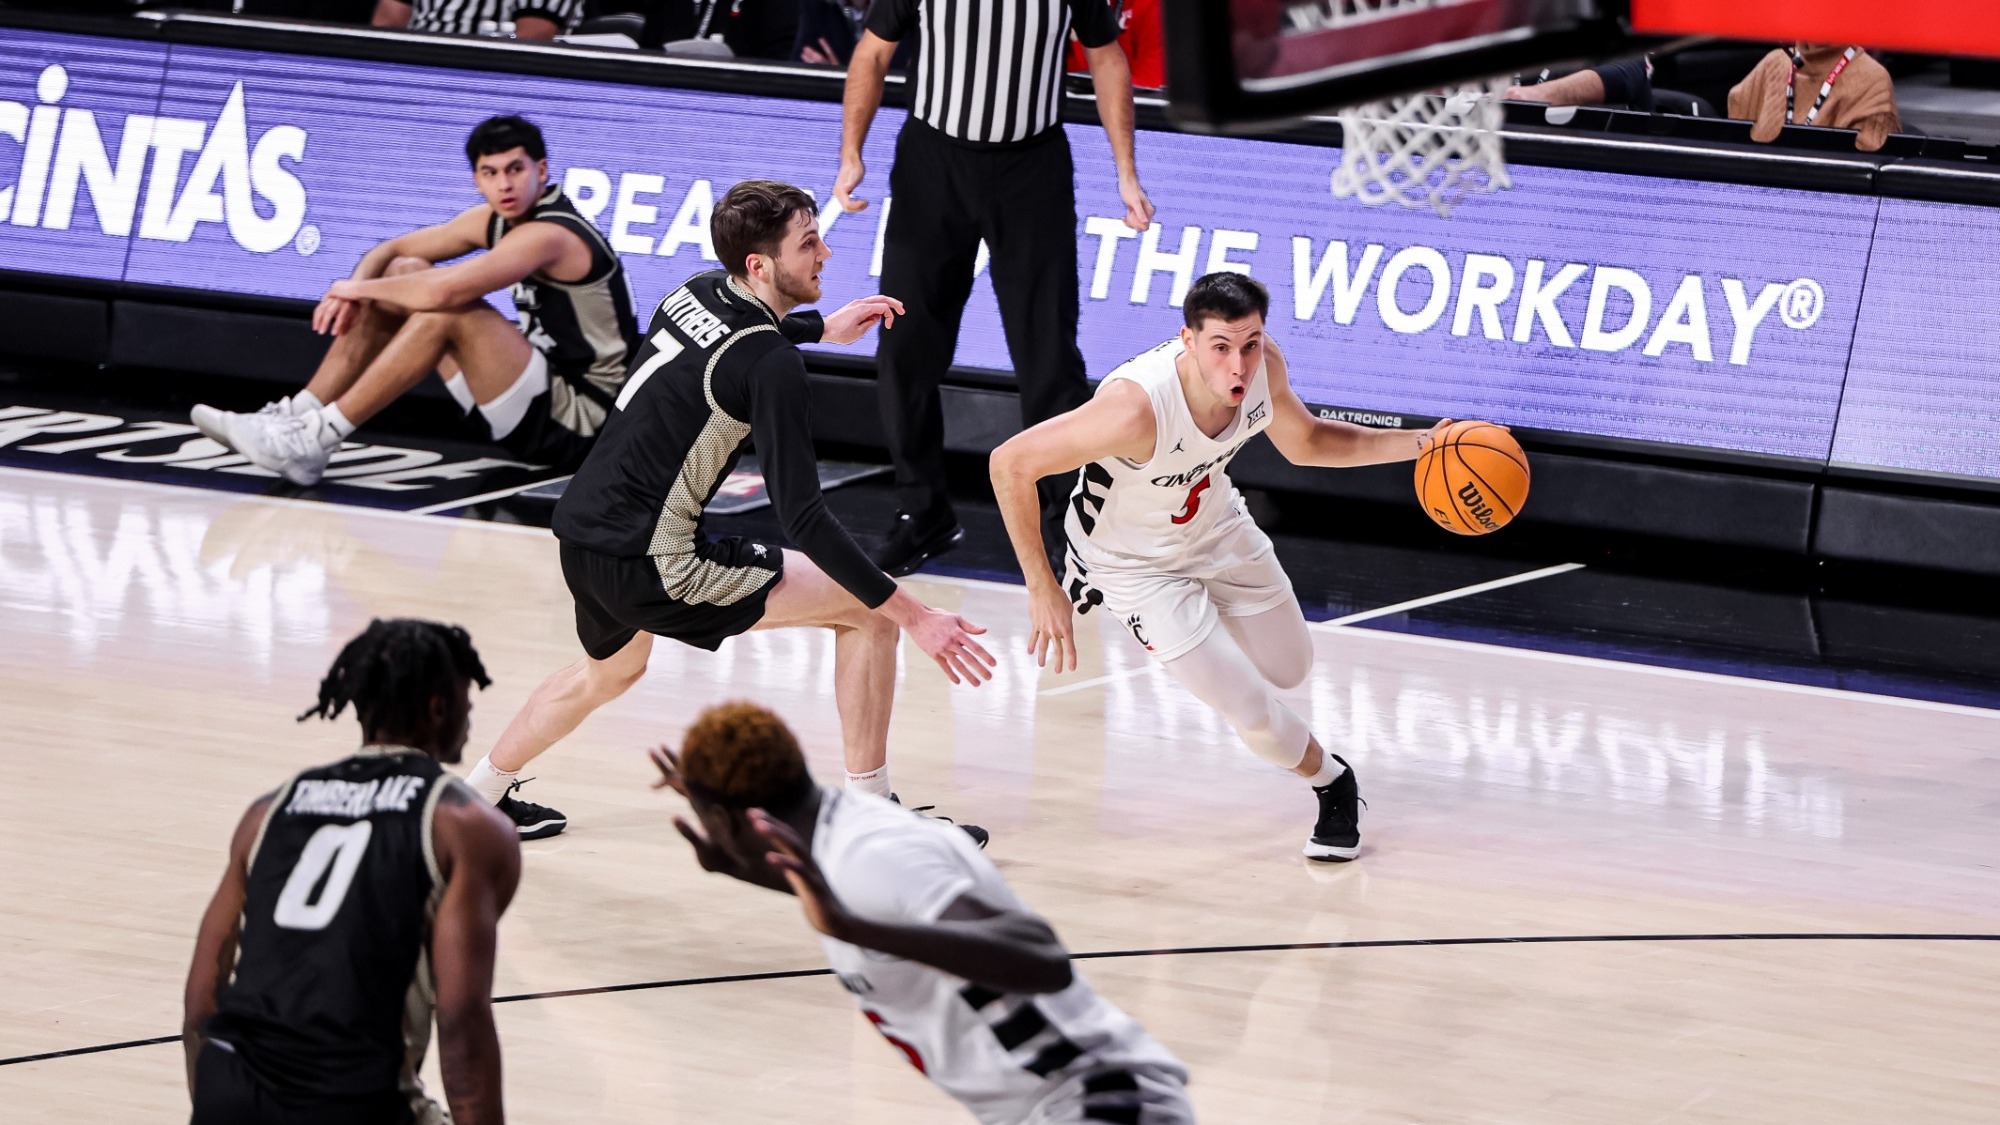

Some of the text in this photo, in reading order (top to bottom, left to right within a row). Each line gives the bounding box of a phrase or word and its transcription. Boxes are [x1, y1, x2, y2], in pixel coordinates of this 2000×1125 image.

[661, 285, 732, 349] WITHERS
[614, 327, 685, 412] 7
[1320, 409, 1402, 427] DAKTRONICS
[1171, 474, 1210, 525] 5
[1458, 480, 1501, 530] Wilso
[273, 819, 373, 931] 0
